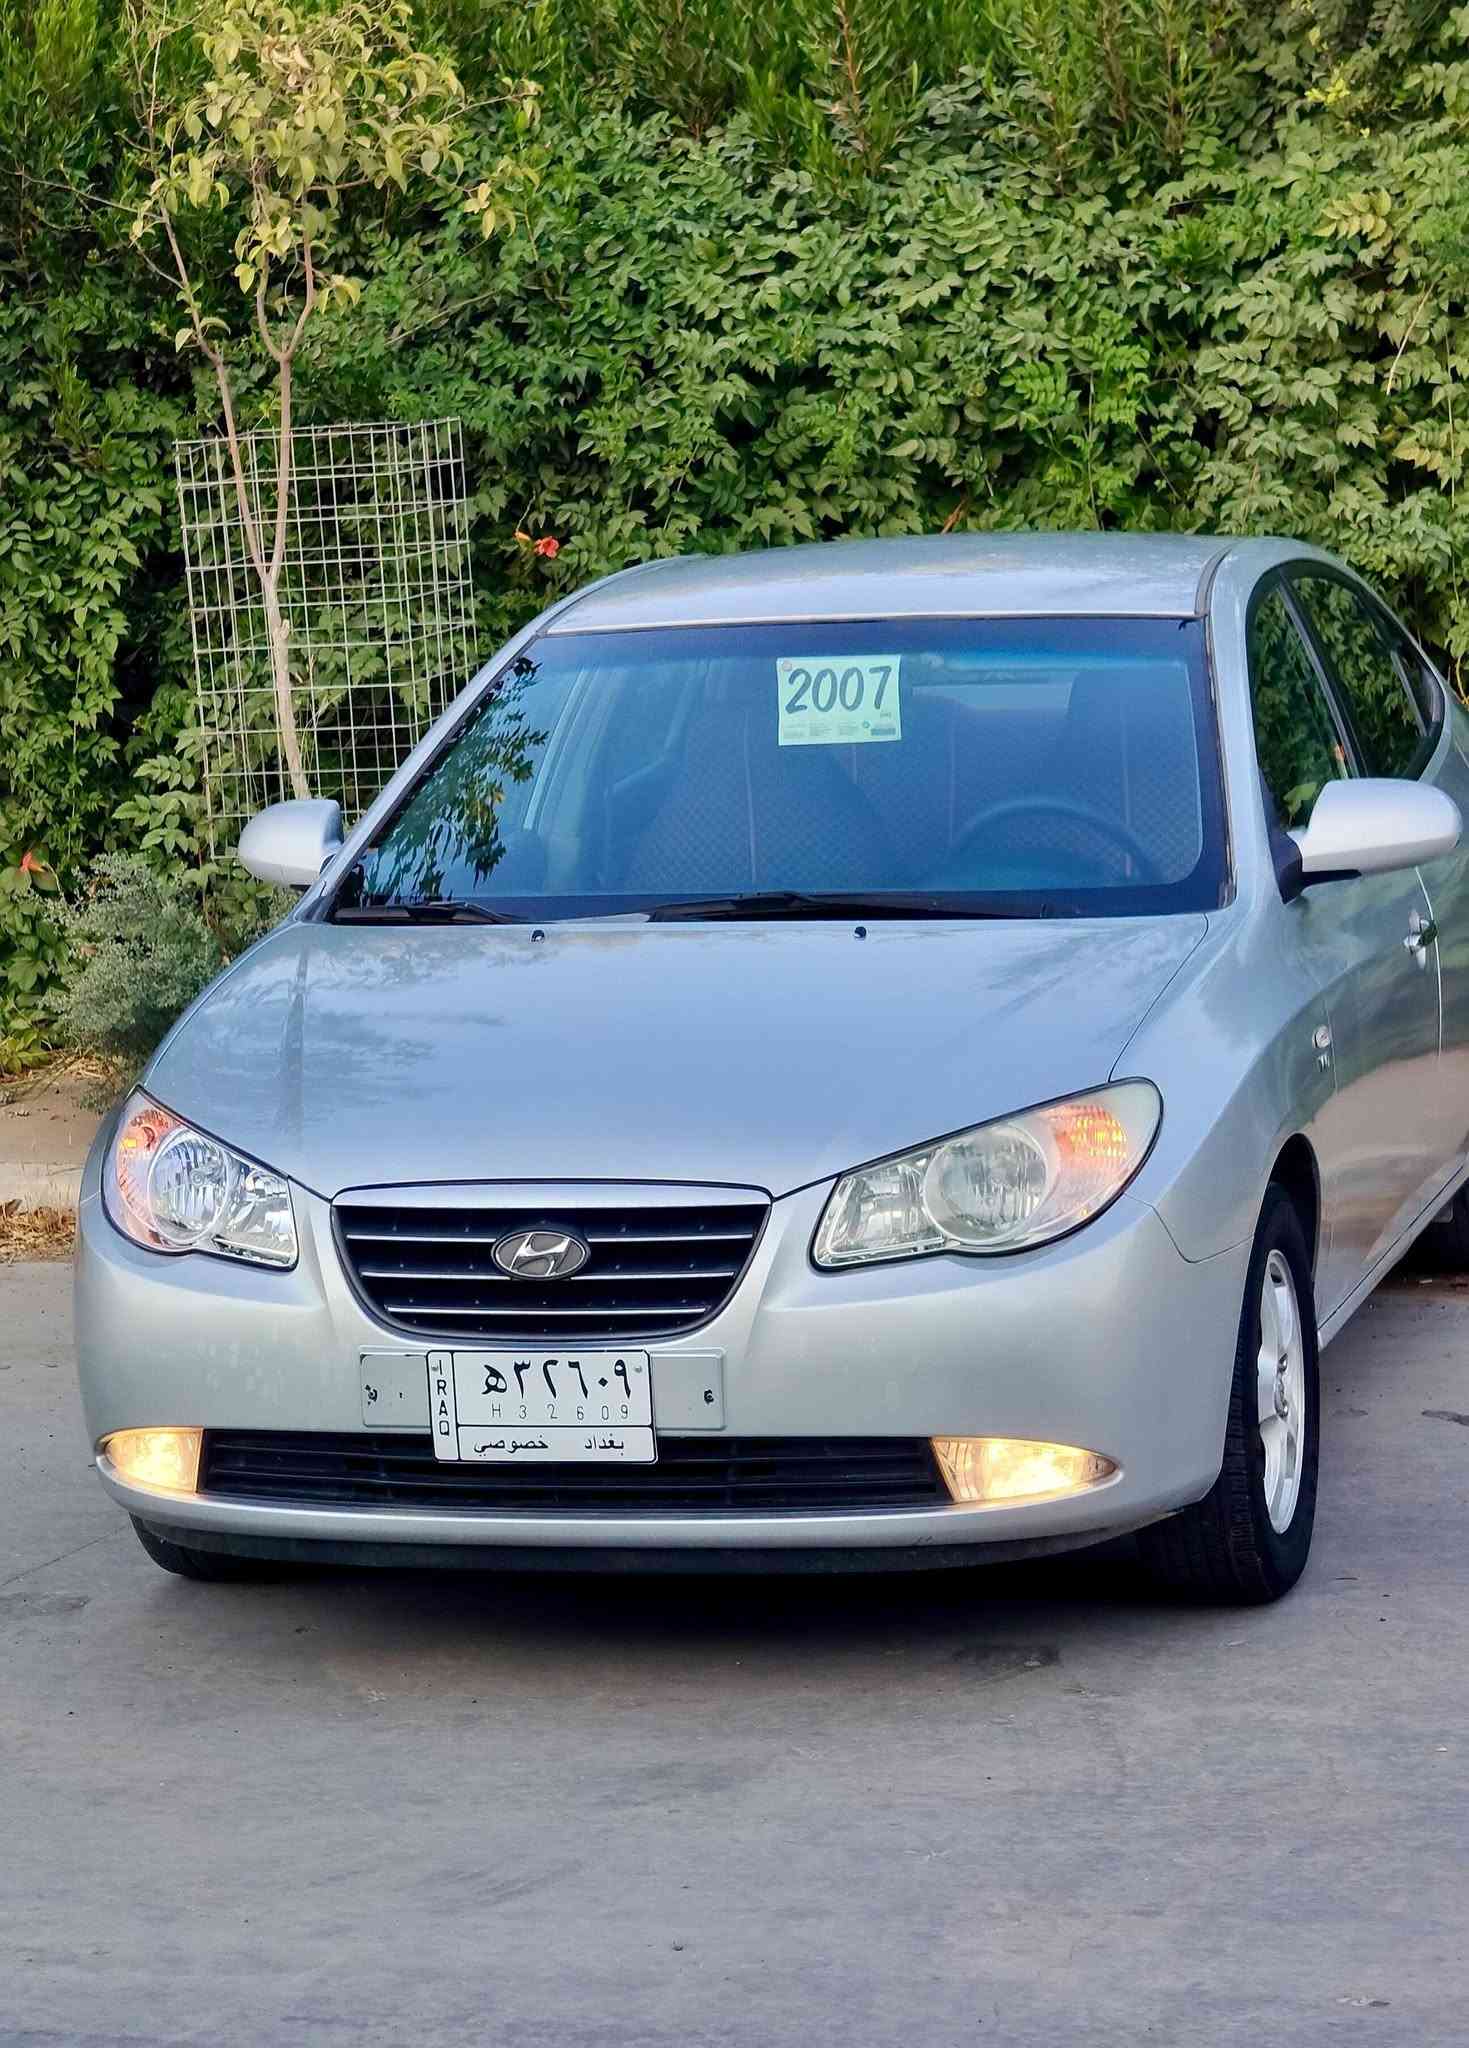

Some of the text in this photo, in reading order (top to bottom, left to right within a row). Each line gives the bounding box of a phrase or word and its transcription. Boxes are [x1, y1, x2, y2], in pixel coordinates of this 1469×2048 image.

[785, 665, 892, 714] 2007
[436, 1359, 450, 1436] IRAQ
[473, 1435, 625, 1458] بغداد خصوصي
